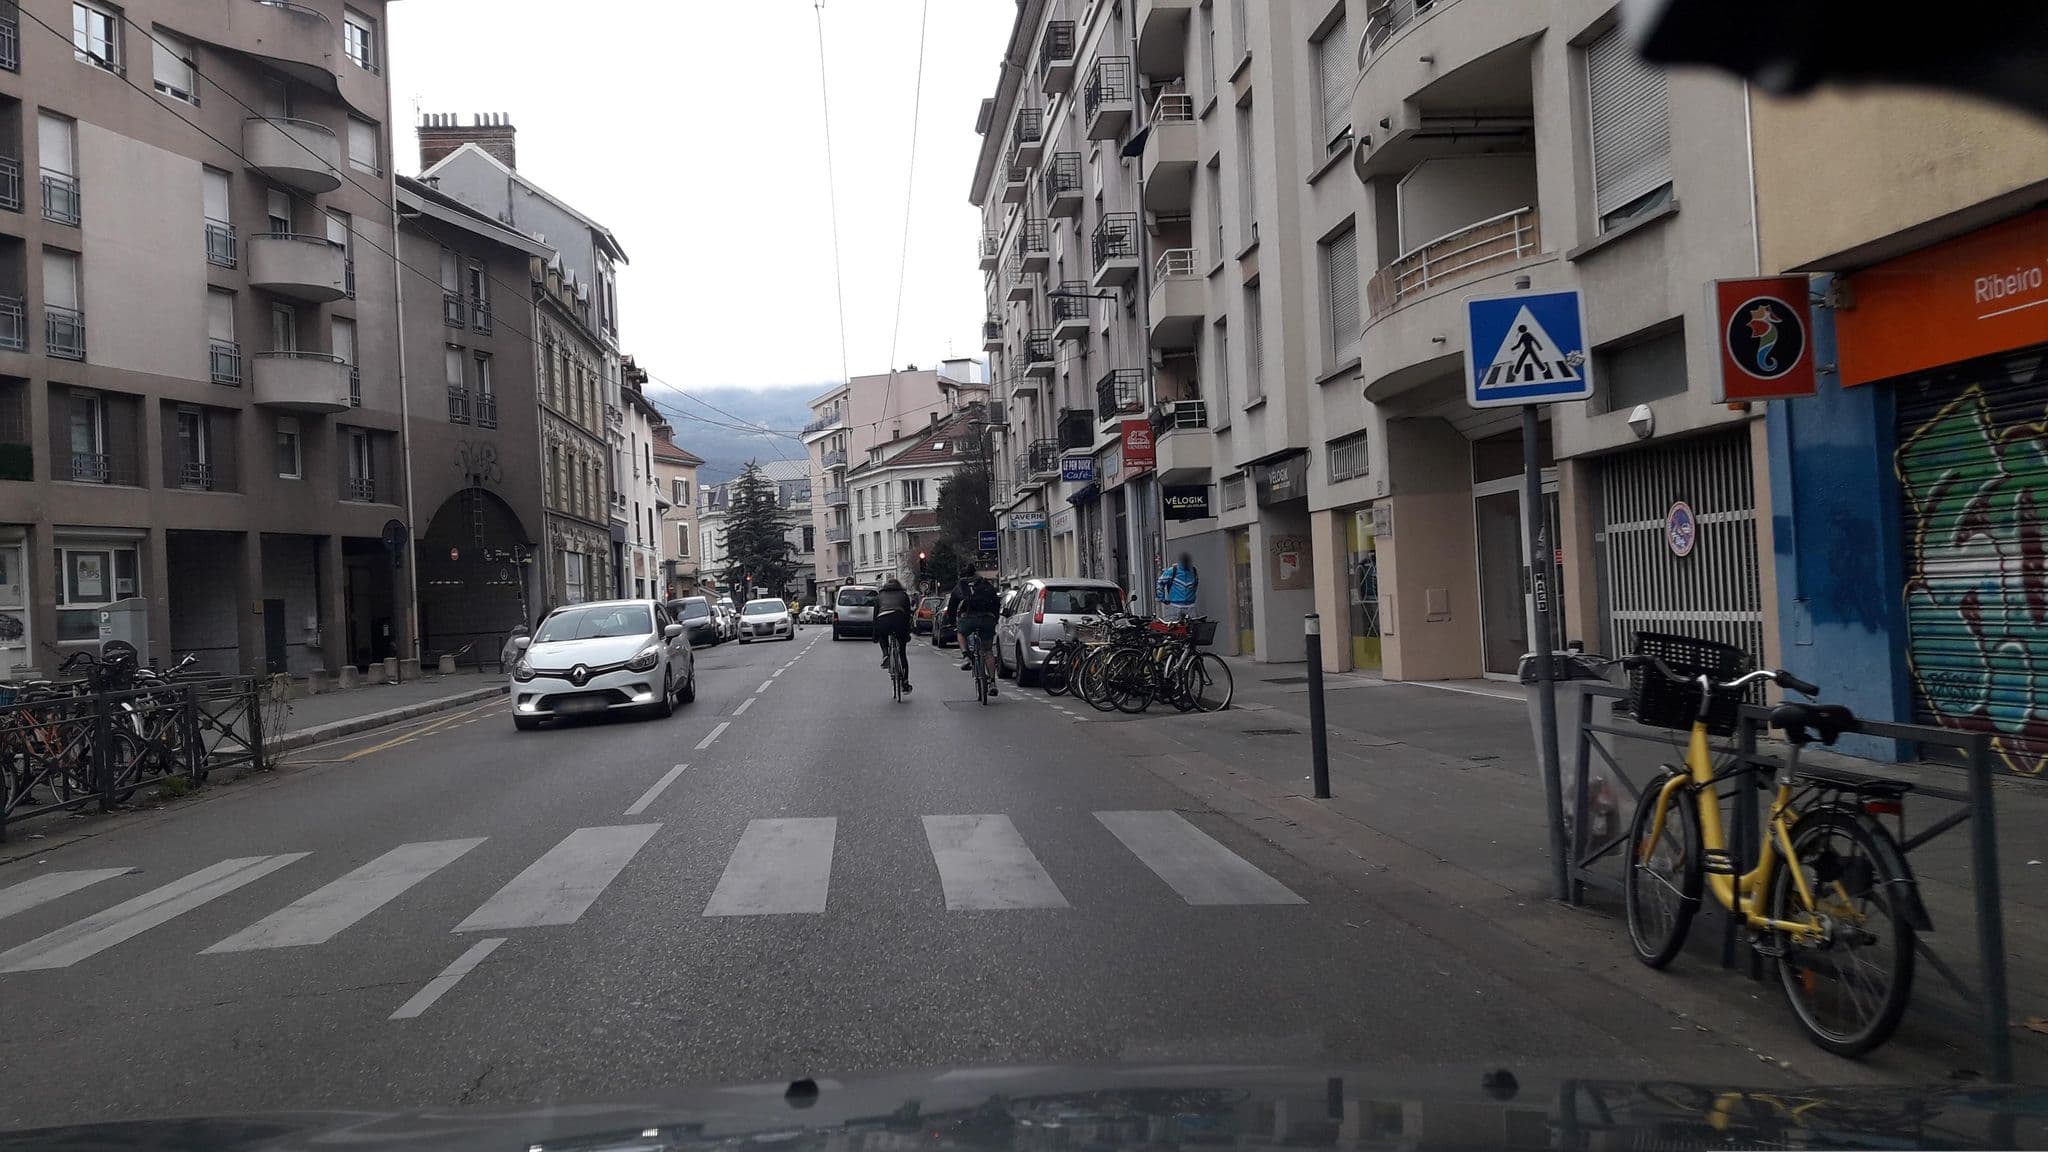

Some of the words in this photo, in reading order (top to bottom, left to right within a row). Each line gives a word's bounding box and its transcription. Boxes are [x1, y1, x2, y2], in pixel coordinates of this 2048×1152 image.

[1975, 266, 2042, 304] Ribeiro
[1010, 513, 1045, 521] LAVERIE
[101, 611, 109, 623] P
